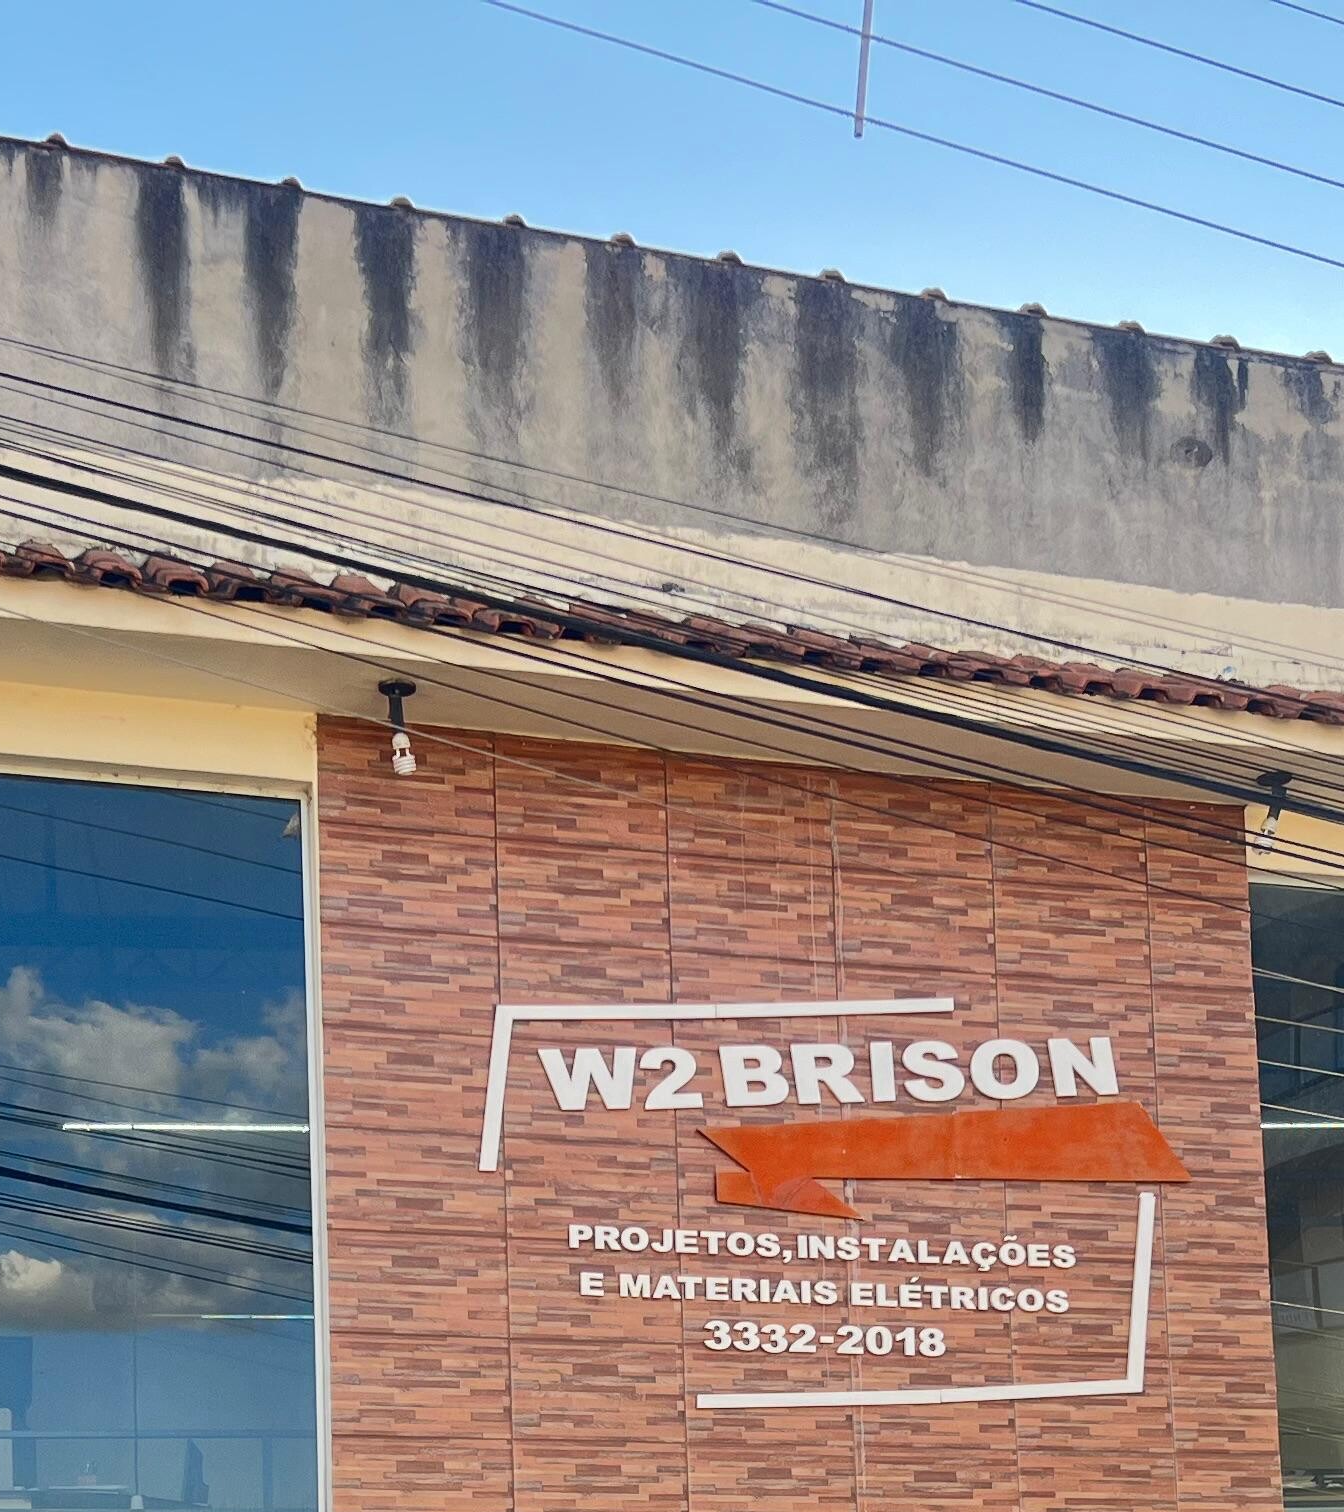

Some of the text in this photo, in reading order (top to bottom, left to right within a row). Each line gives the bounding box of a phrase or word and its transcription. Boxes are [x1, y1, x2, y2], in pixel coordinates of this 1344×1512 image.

[537, 1036, 1120, 1111] W2 BRISON
[580, 1272, 1070, 1314] E MATERIAIS ELÉTRICOS
[703, 1319, 946, 1357] 3332-2018
